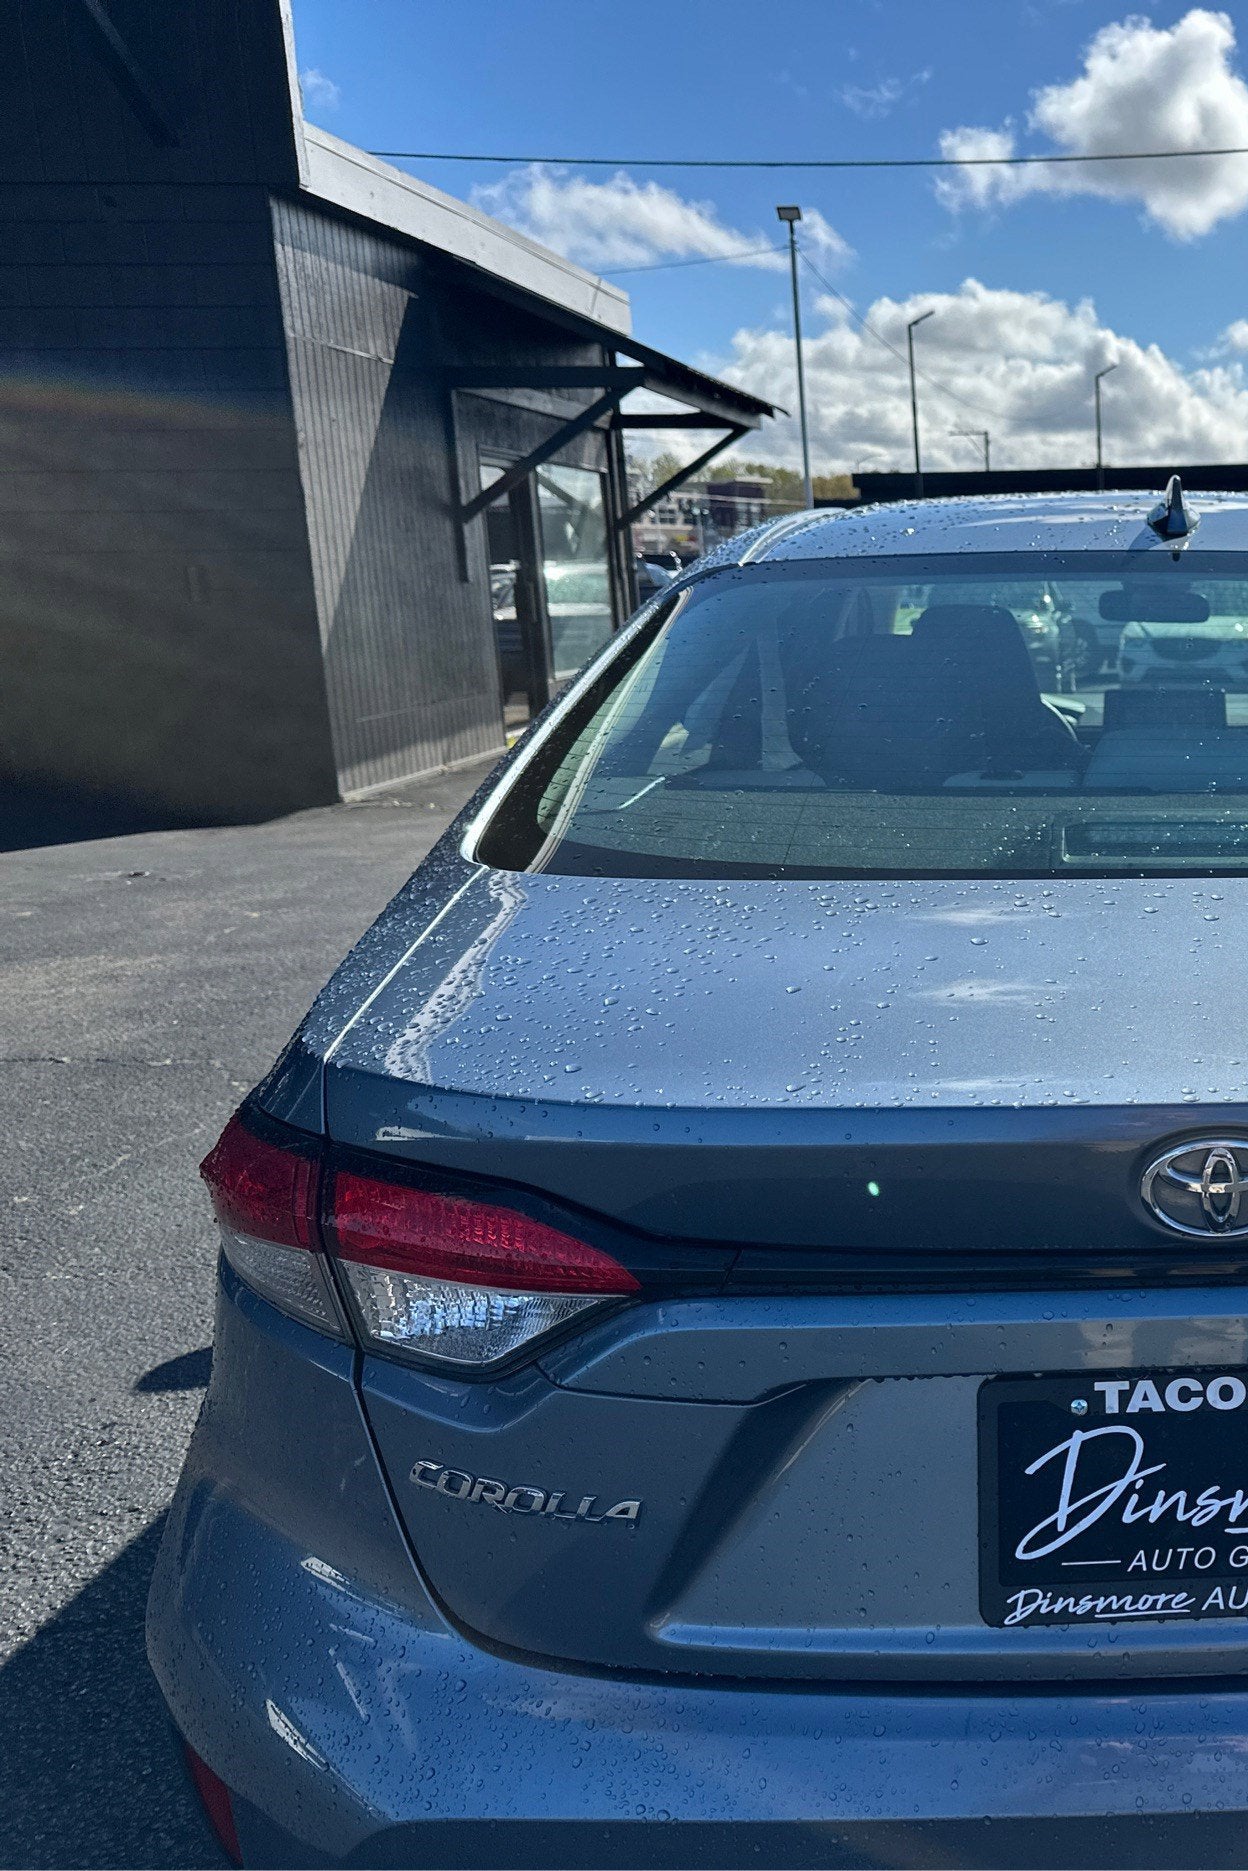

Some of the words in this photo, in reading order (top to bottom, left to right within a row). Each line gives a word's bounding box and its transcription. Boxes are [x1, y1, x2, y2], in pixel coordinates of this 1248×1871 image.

[408, 1459, 644, 1522] COROLLA
[1127, 1546, 1217, 1573] AUTO
[1003, 1587, 1196, 1625] Dinsmore
